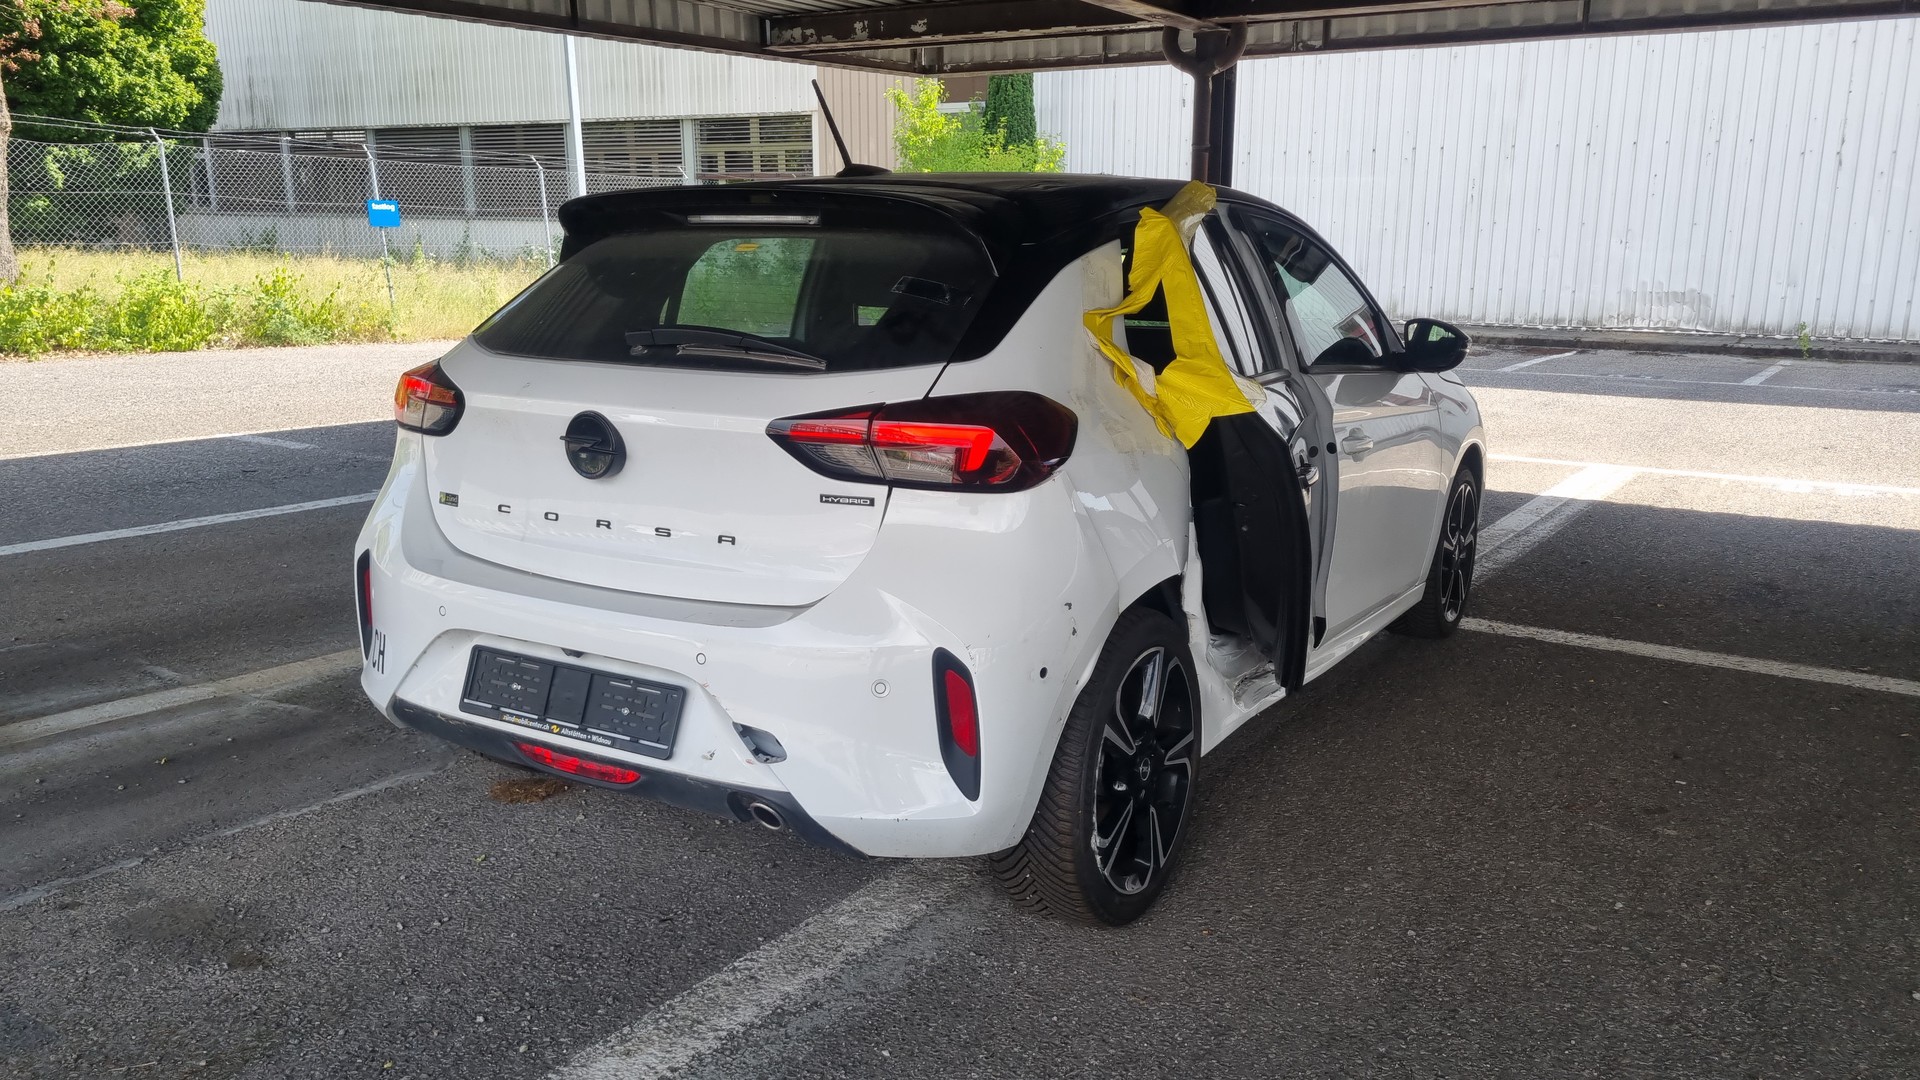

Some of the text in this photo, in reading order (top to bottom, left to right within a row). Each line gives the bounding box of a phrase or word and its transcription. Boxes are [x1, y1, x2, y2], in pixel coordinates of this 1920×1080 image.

[822, 496, 870, 505] HYBRID
[497, 503, 736, 546] CORSA
[372, 628, 386, 675] CH
[591, 734, 612, 745] Widnau
